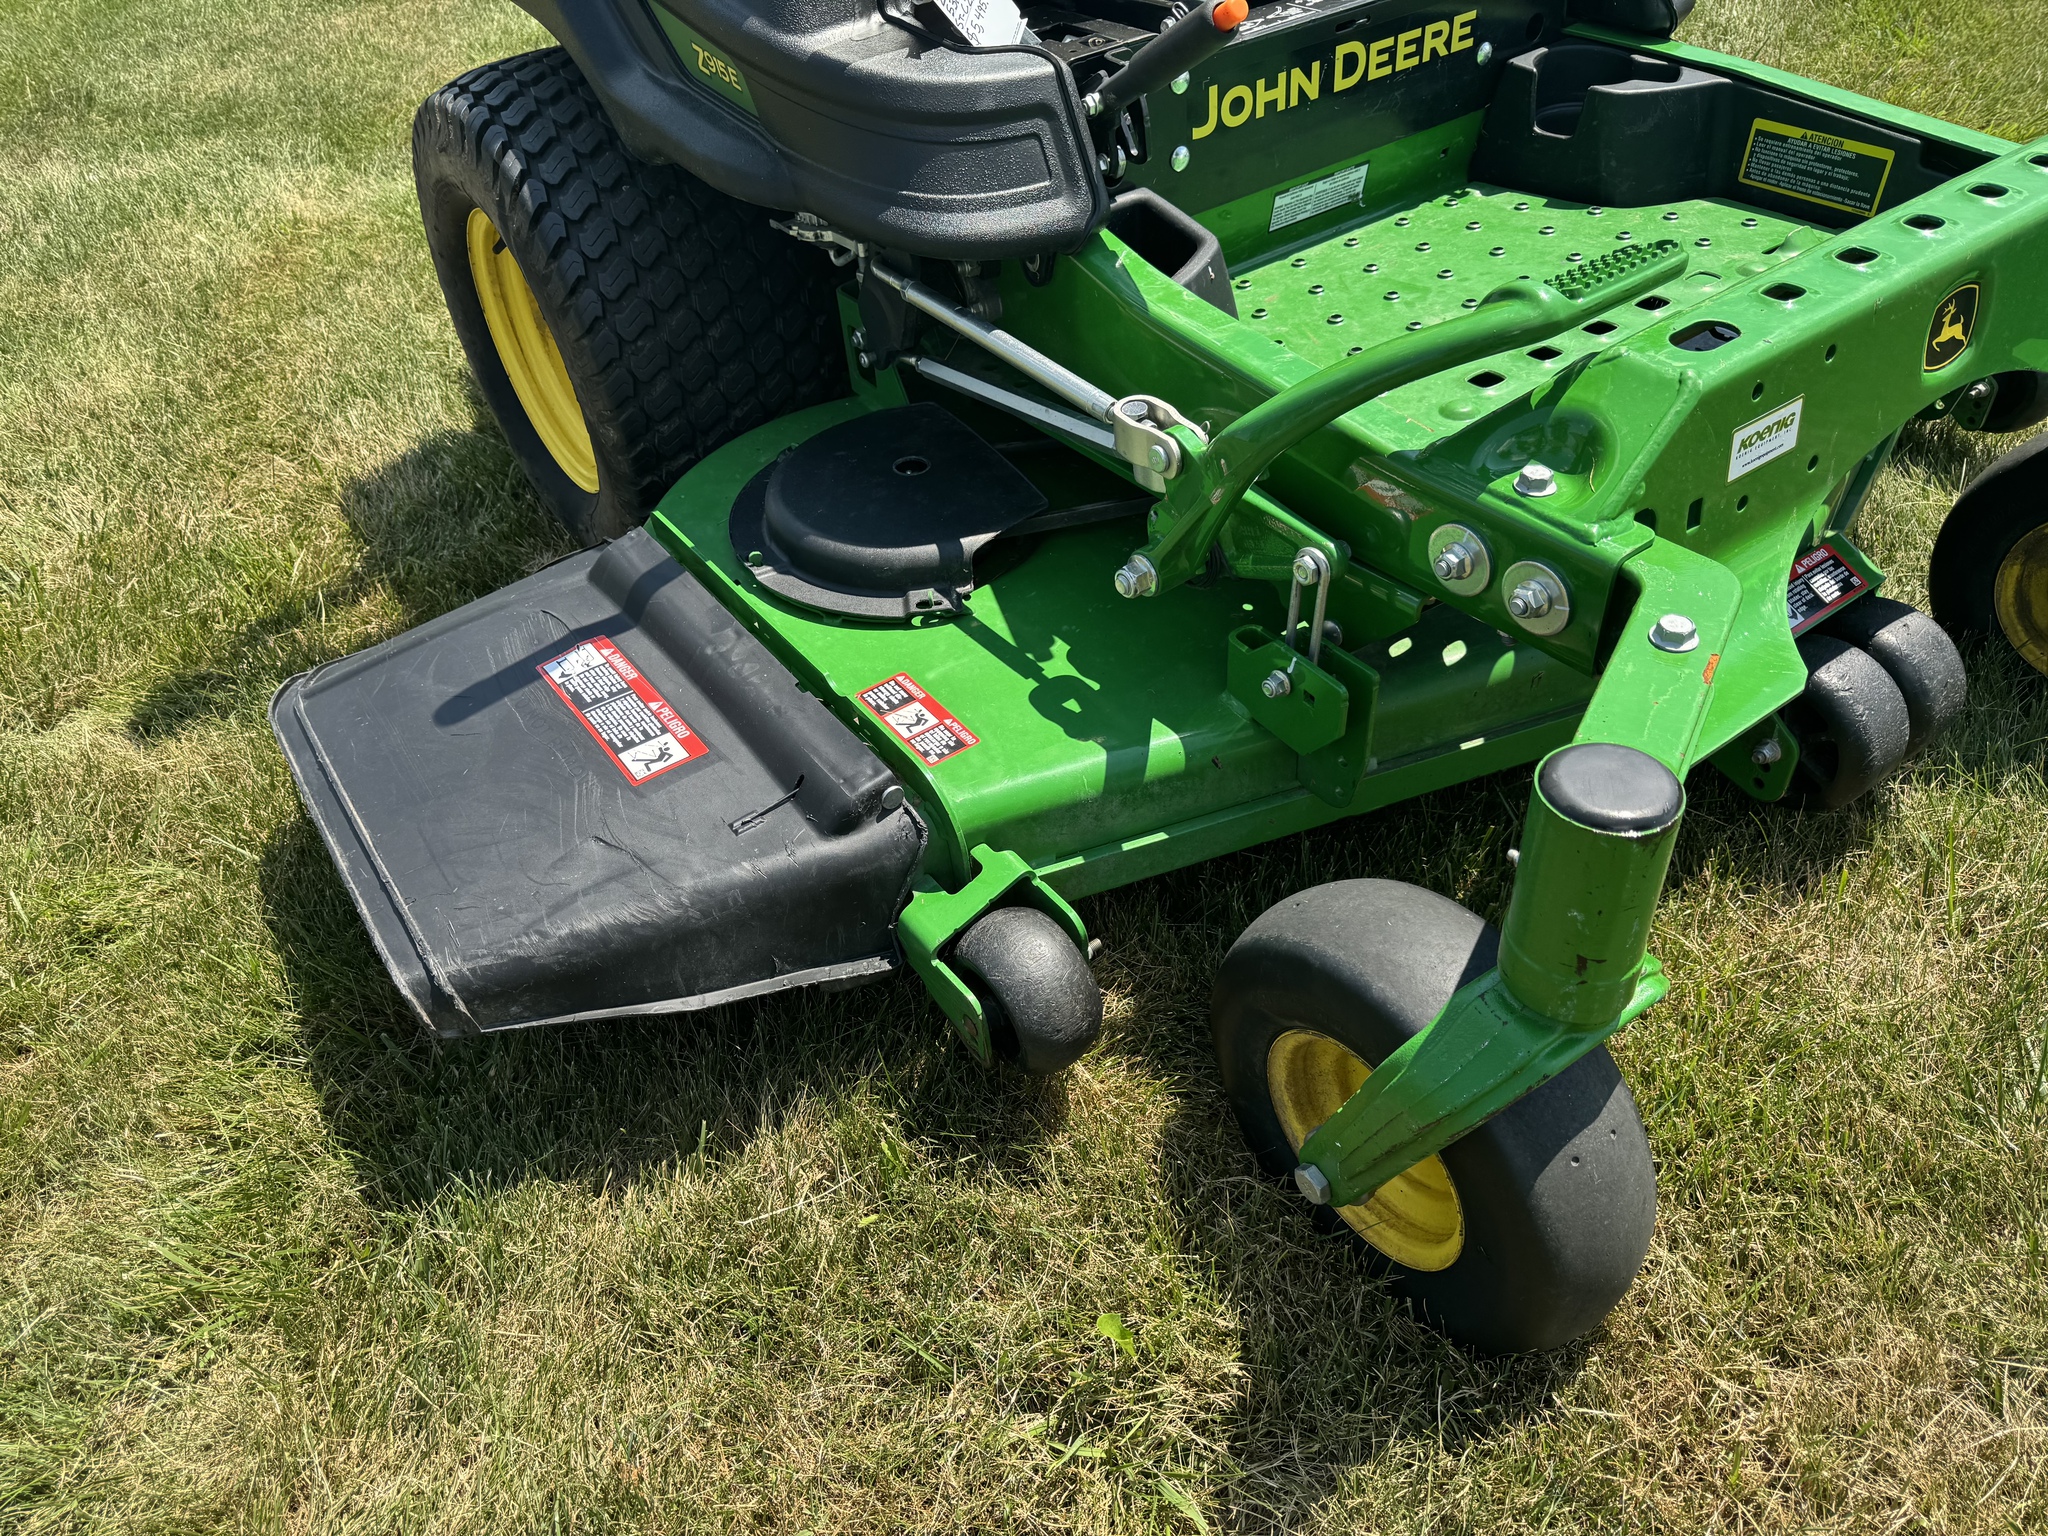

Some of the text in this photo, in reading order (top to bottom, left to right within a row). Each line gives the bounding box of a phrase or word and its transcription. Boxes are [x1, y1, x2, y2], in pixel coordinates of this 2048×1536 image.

[691, 42, 743, 91] Z915E
[1192, 10, 1478, 140] JOHN DEERE
[1809, 133, 1844, 149] ATENCION
[1813, 143, 1830, 154] EVITAR
[1831, 148, 1856, 160] LESIONES
[608, 653, 637, 681] DANGER
[902, 679, 926, 699] DANGER
[657, 707, 690, 739] PELIGRO
[949, 722, 976, 745] PELIGRO
